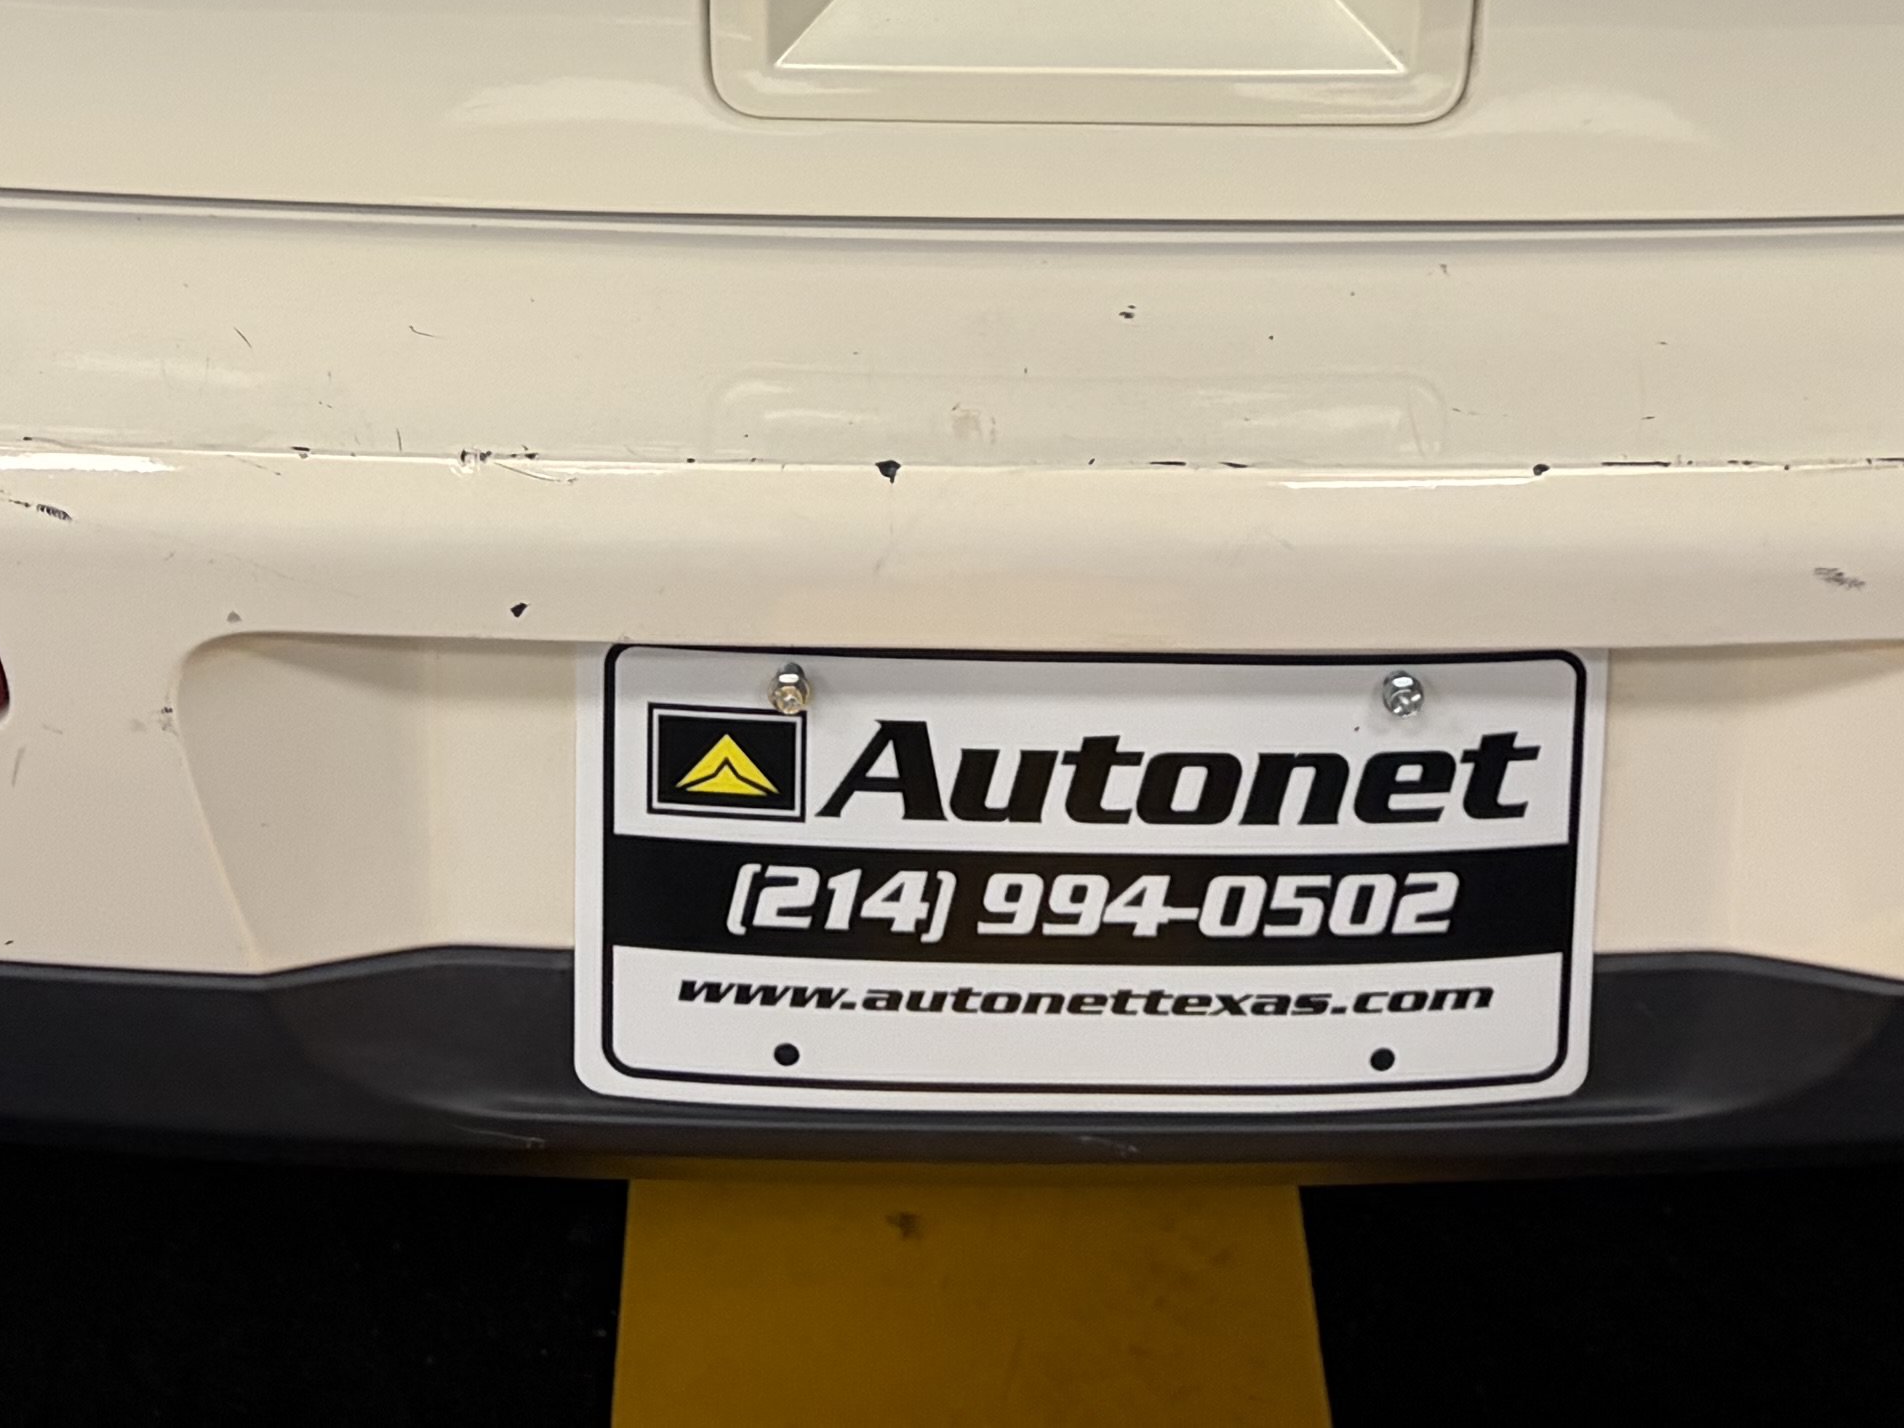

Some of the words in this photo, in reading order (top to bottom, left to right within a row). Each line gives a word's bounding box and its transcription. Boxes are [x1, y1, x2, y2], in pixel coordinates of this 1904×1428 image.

[814, 719, 1542, 826] Autonet
[726, 863, 957, 943] (214)
[977, 871, 1460, 938] 994-0502
[677, 978, 1495, 1017] www.autonettexas.com
